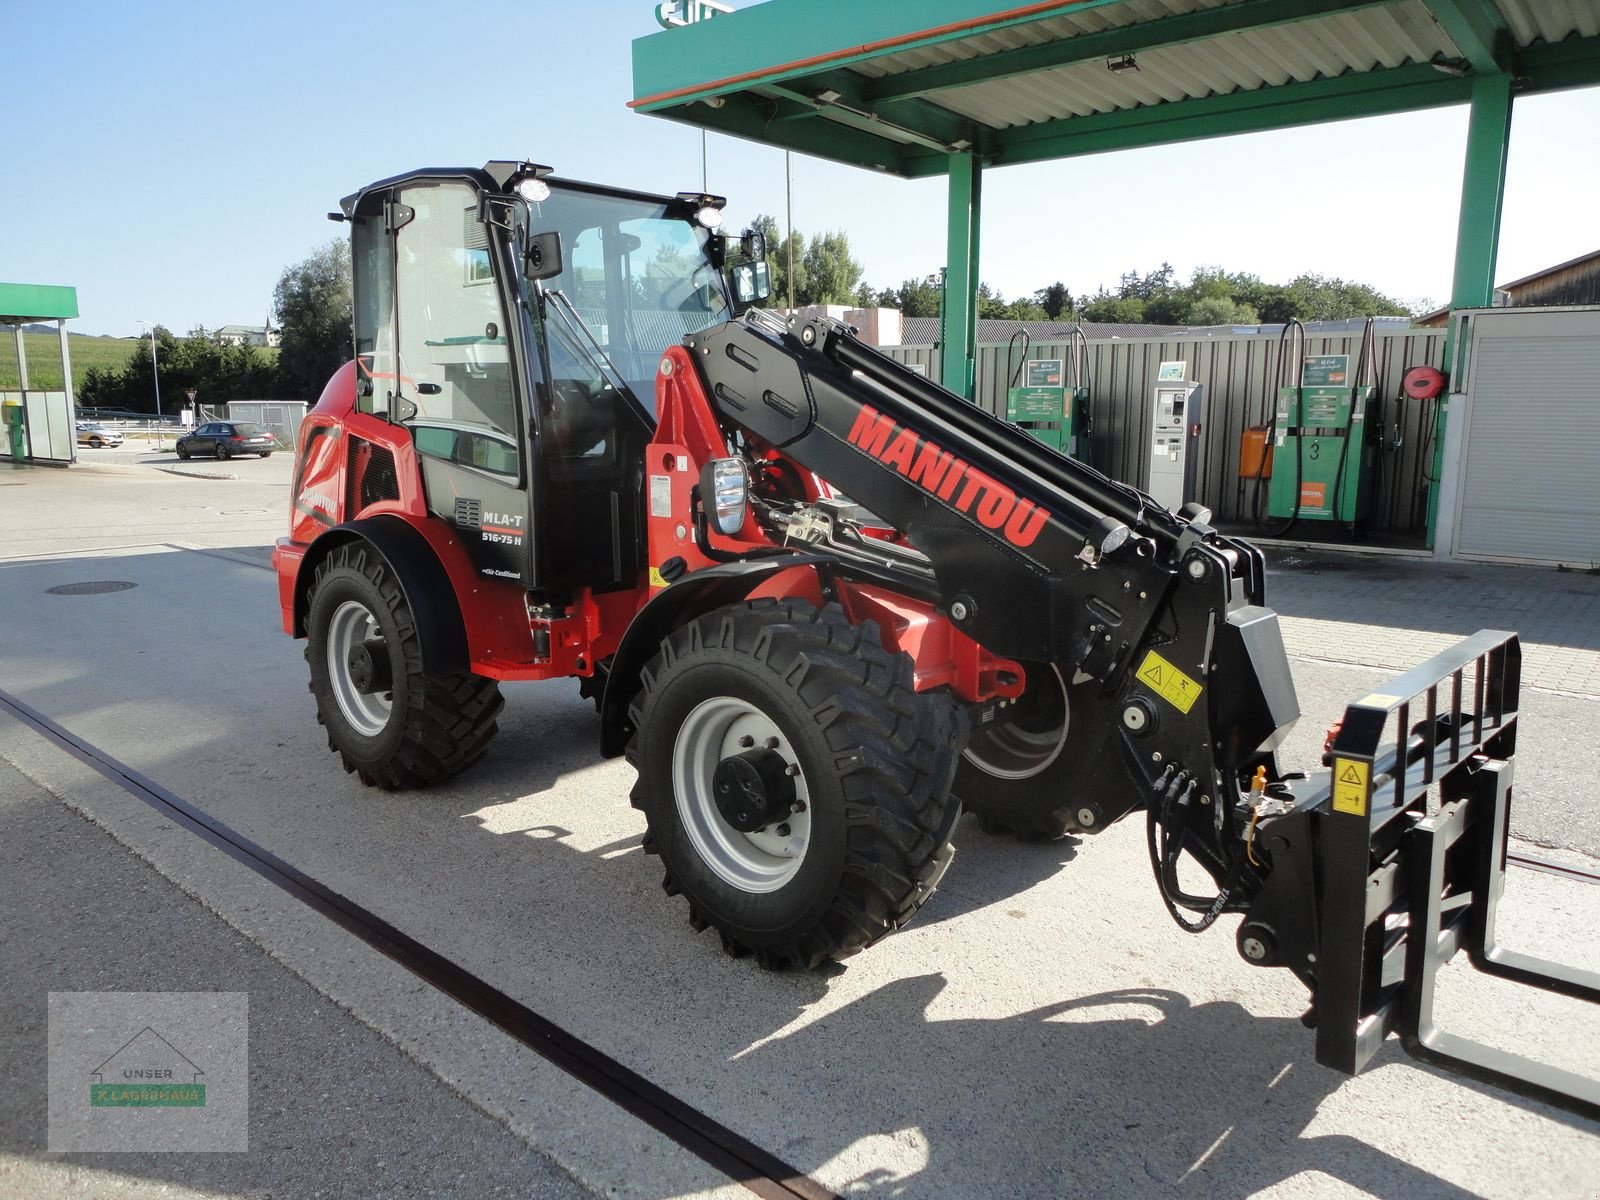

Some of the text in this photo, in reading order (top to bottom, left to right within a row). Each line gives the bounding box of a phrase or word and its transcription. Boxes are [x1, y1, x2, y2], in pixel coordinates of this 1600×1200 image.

[1309, 443, 1320, 460] 3
[847, 403, 1051, 548] MANITOU
[483, 511, 523, 527] MLA-T
[482, 532, 522, 546] 516-75 H
